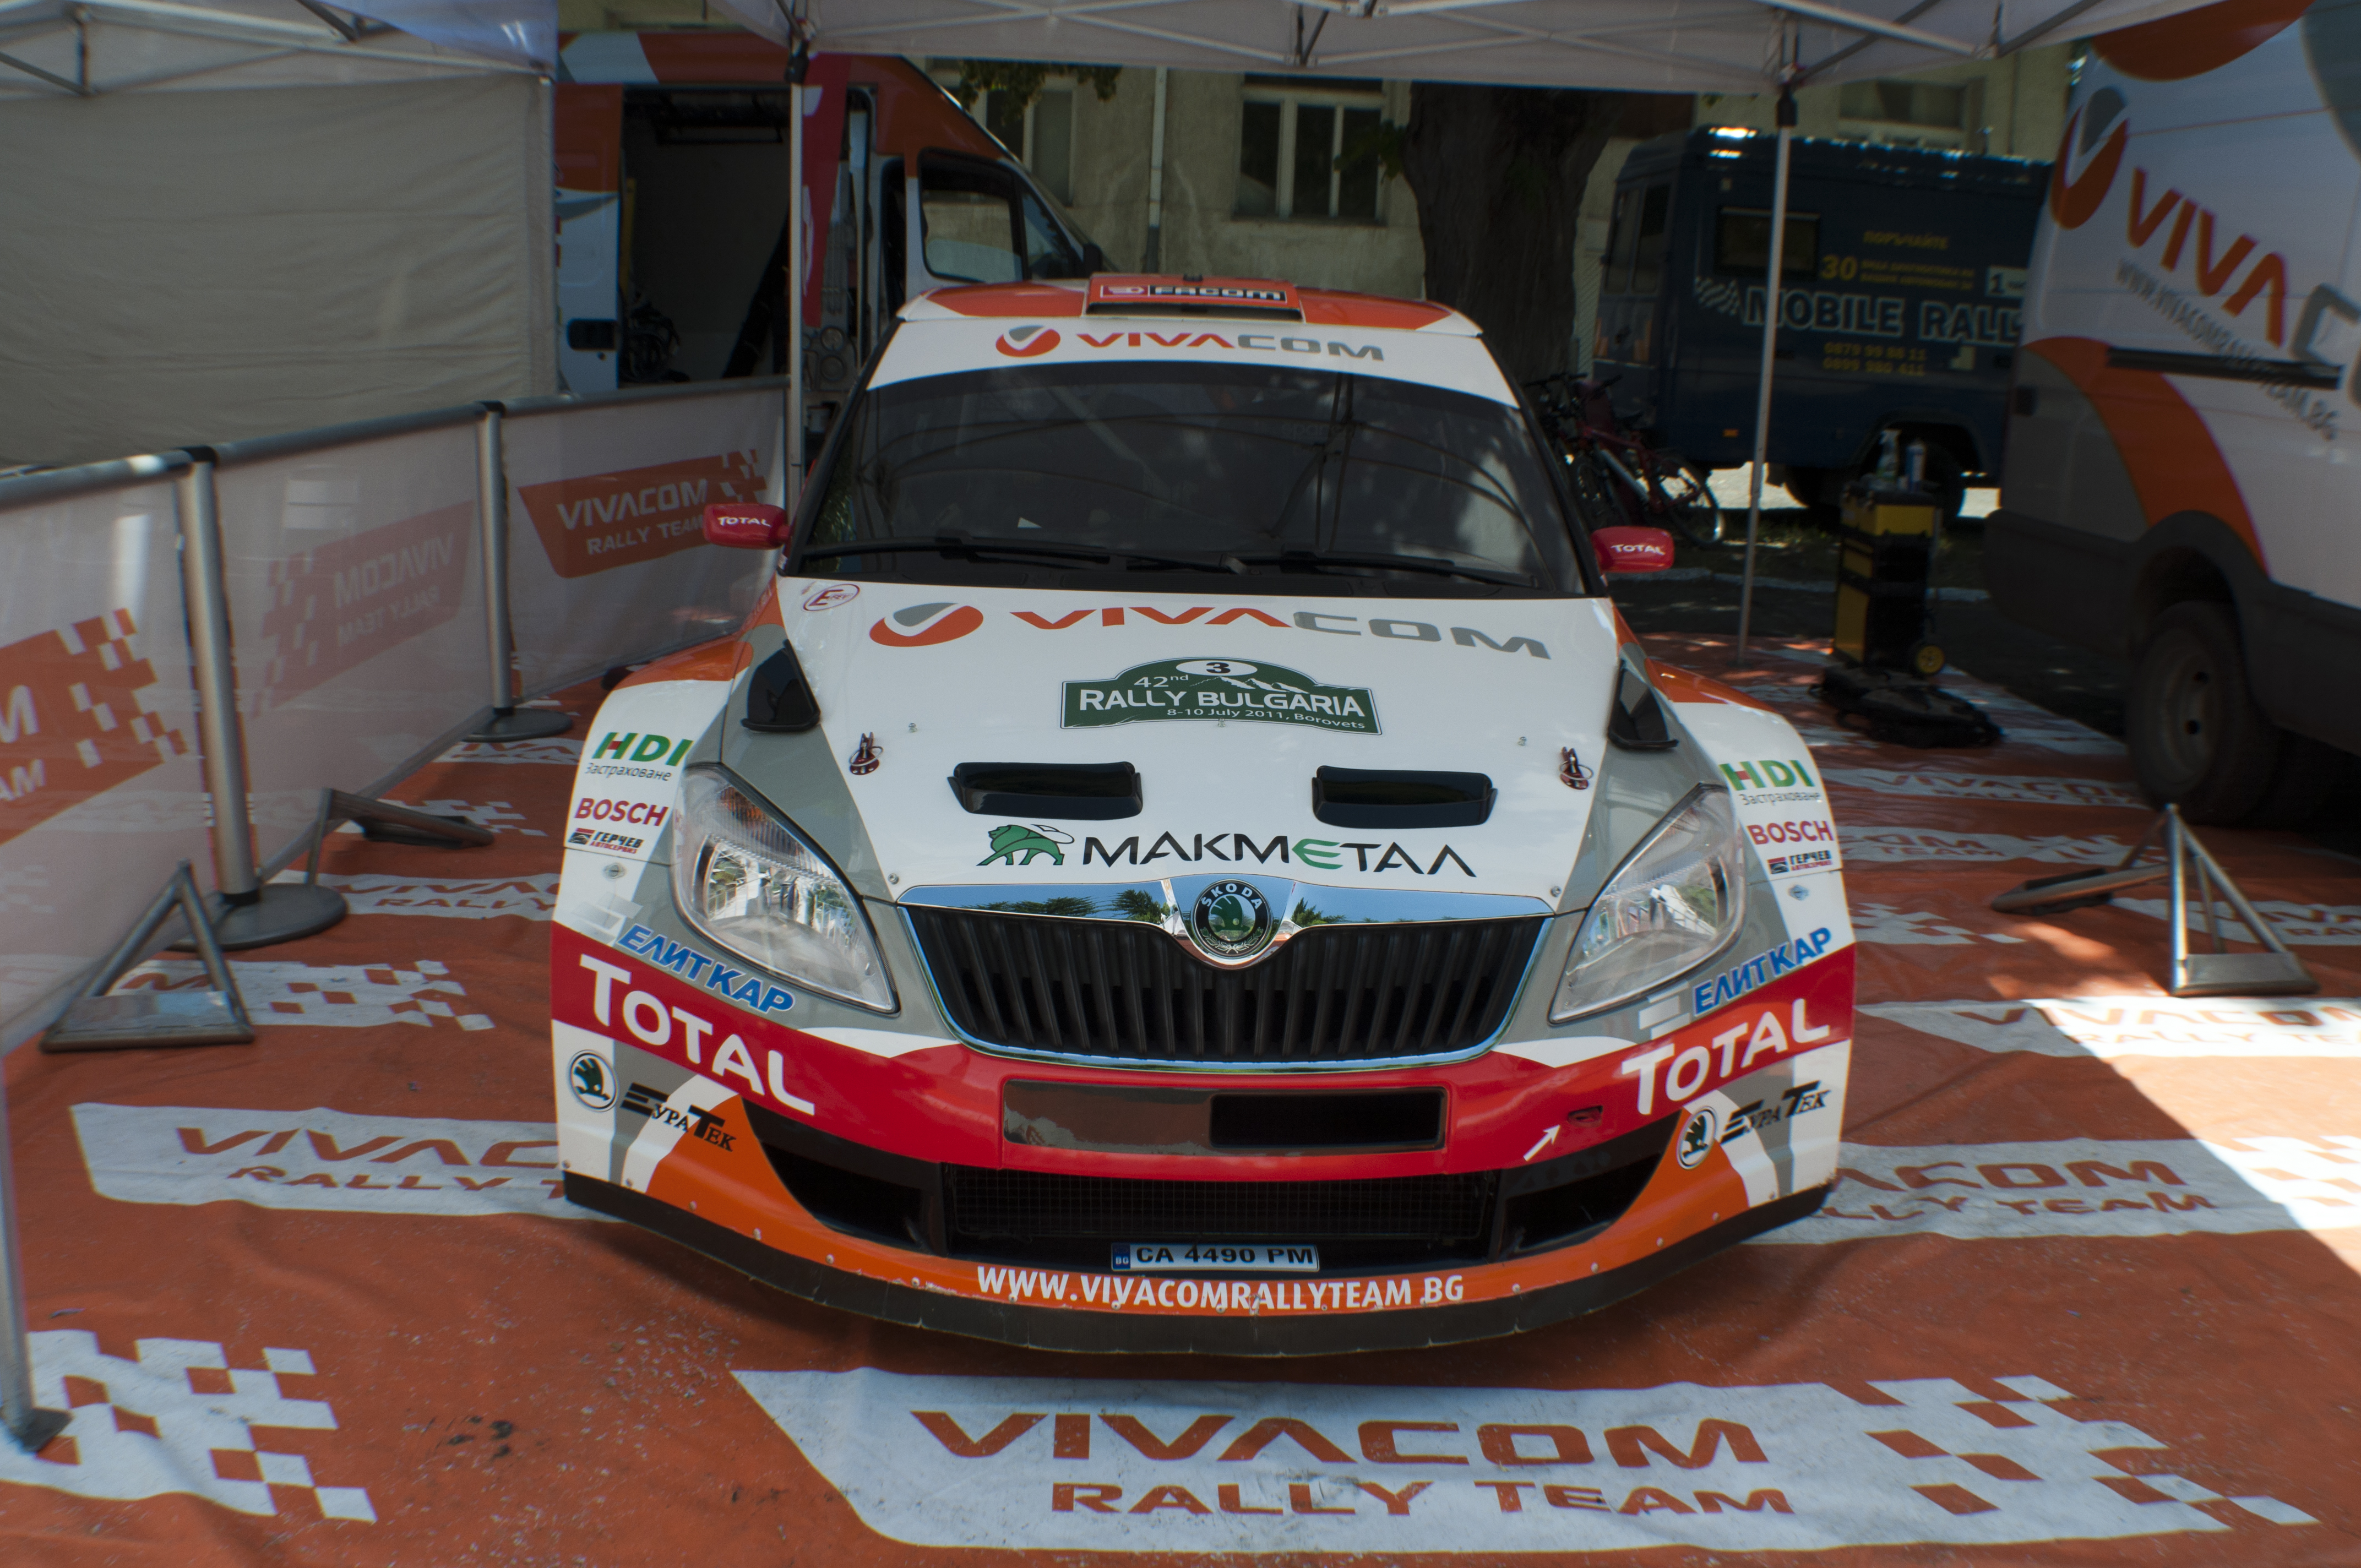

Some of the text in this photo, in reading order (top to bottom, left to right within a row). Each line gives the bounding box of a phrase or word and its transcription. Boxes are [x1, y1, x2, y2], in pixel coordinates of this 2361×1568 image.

[1819, 253, 1858, 281] 30
[1744, 285, 1905, 338] MOBILE
[1076, 332, 1384, 361] VIVACOM
[556, 478, 708, 531] VIVACOM
[717, 516, 771, 527] TOTAL
[586, 526, 651, 556] RALLY
[1611, 543, 1666, 556] TOTAL
[1010, 607, 1551, 660] VIVACOM
[1134, 674, 1189, 688] 42nd
[1206, 662, 1231, 674] 3
[1080, 689, 1366, 717] RALLY BULGARIA
[1207, 709, 1241, 717] July
[1294, 713, 1366, 728] Borovets
[592, 732, 694, 766] HDI
[585, 763, 672, 782] Застраховане
[1718, 760, 1815, 791] HDI
[575, 797, 669, 827] BOSCH
[1739, 791, 1822, 807] Застраховане
[594, 831, 644, 848] ГЕРЧЕВ
[1747, 820, 1834, 845] BOSCH
[1788, 850, 1831, 865] ГЕРЧЕВ
[579, 953, 815, 1117] TOTAL
[1621, 998, 1830, 1116] TOTAL
[227, 1164, 513, 1191] RALLY
[1995, 1191, 2219, 1217] TEAM
[1116, 1256, 1129, 1265] BG
[1136, 1246, 1314, 1265] CA 4490 PM
[910, 1411, 1769, 1470] VIVACOM
[1051, 1481, 1795, 1517] RALLY TEAM
